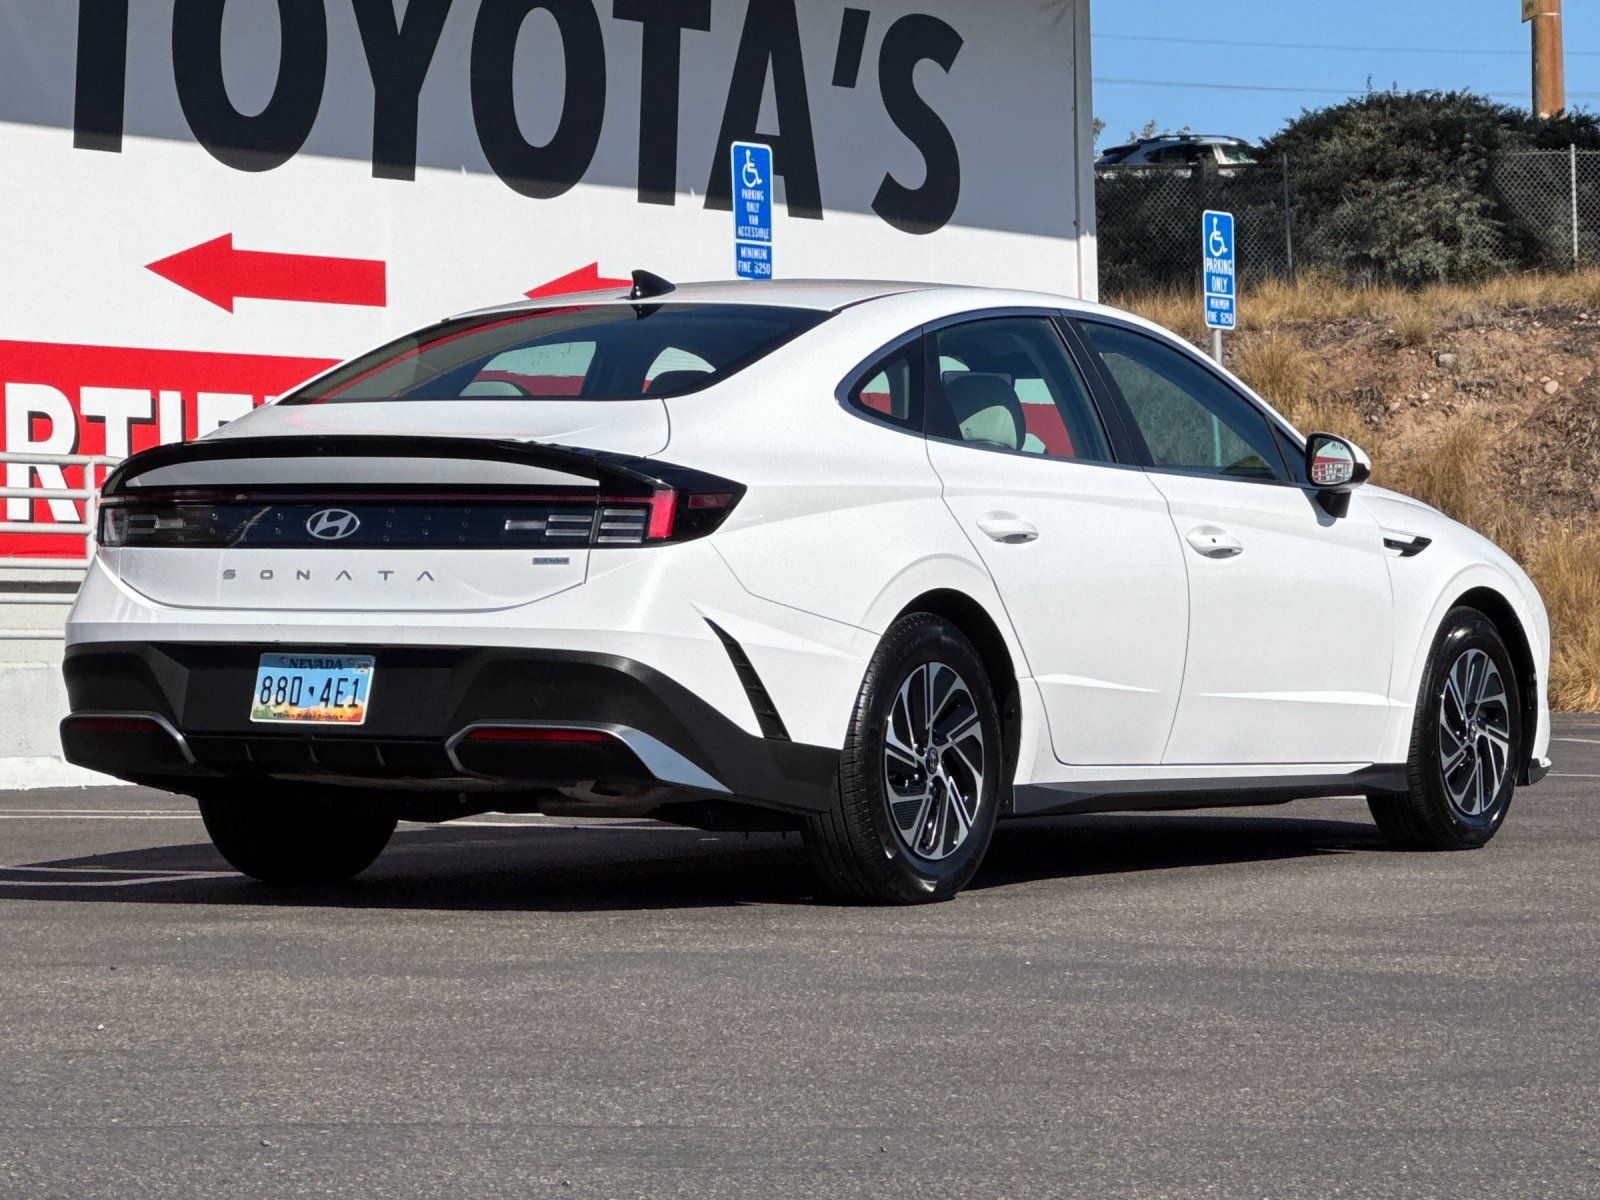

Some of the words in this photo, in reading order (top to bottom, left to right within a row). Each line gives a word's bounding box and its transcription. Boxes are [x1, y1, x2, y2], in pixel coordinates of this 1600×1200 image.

[741, 188, 765, 202] PARKING
[746, 201, 760, 213] ONLY
[738, 226, 769, 240] ACCESSIBLE
[740, 246, 768, 260] MINIMUM
[738, 260, 752, 274] FINE
[753, 262, 771, 275] $250
[1206, 257, 1233, 275] PARKING
[1211, 275, 1228, 293] ONLY
[222, 569, 435, 581] SONATA
[288, 658, 344, 670] NEVADA
